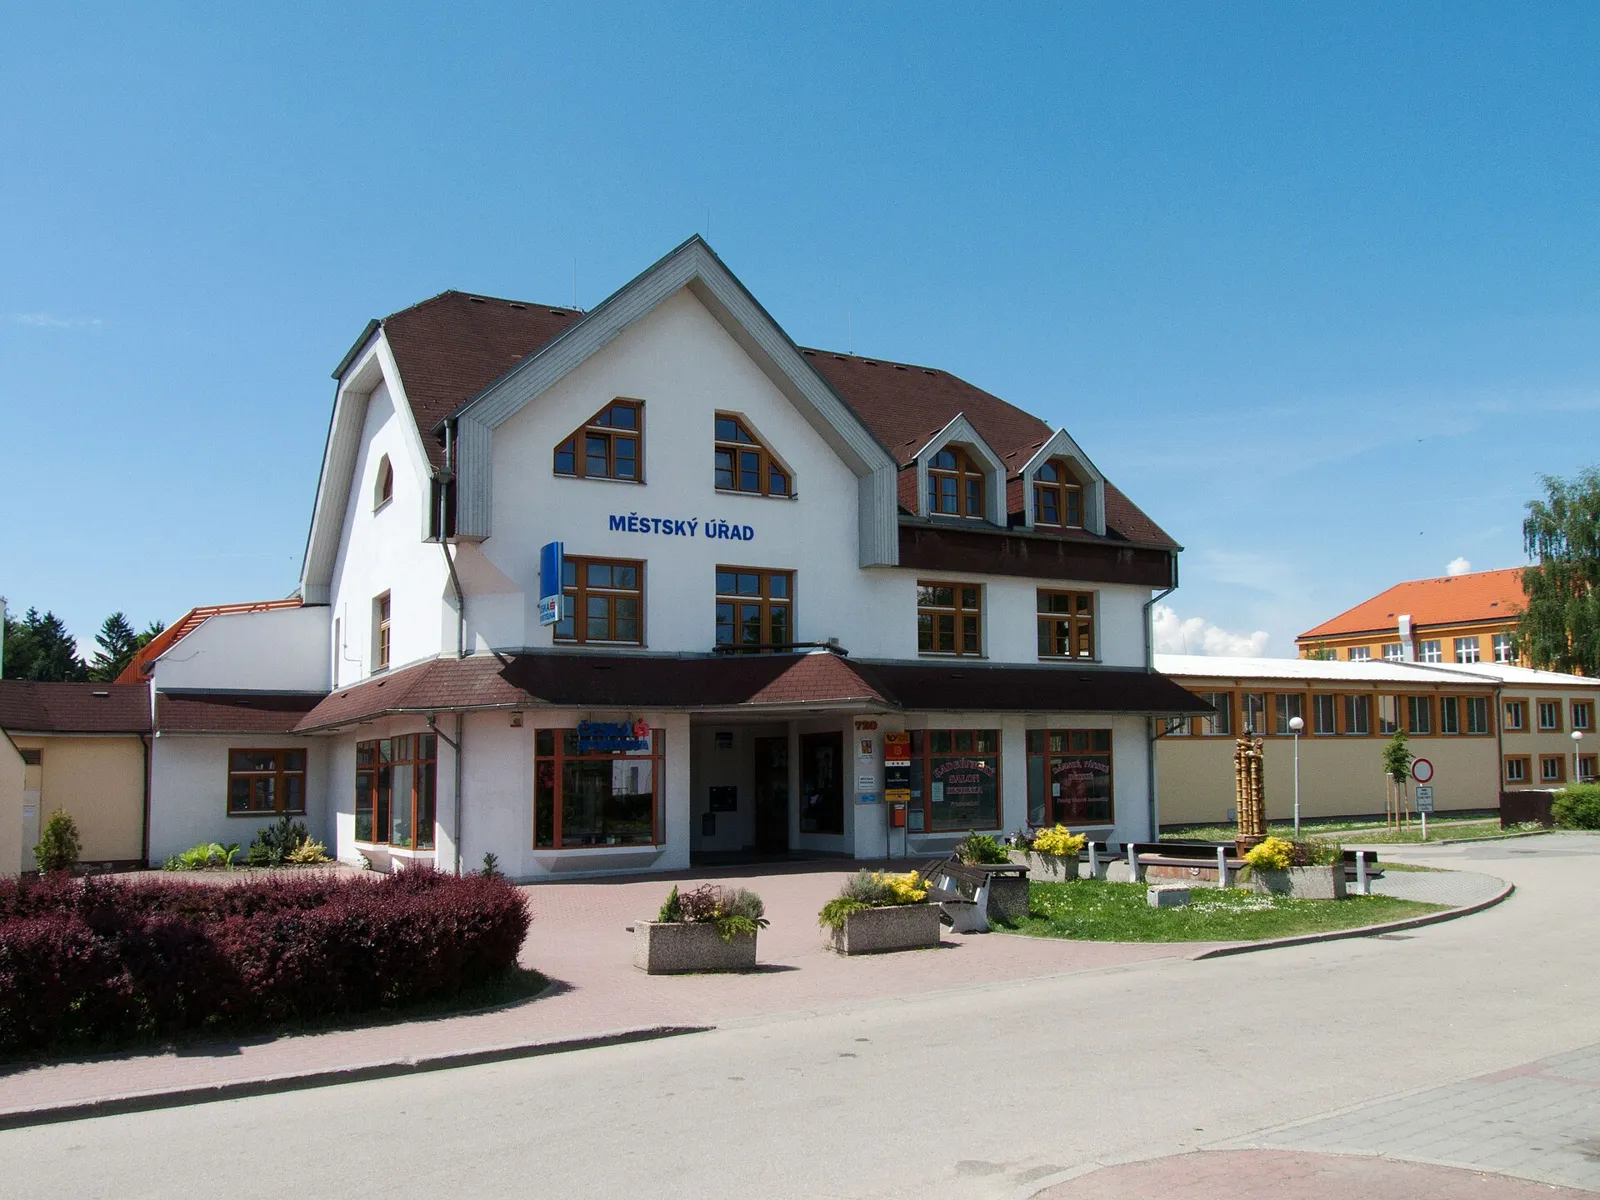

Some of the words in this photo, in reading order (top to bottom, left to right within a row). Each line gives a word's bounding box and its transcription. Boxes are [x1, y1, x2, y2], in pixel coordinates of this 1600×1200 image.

[609, 511, 698, 537] MĚSTSKÝ
[704, 518, 755, 541] ÚŘAD
[948, 774, 980, 784] SALON
